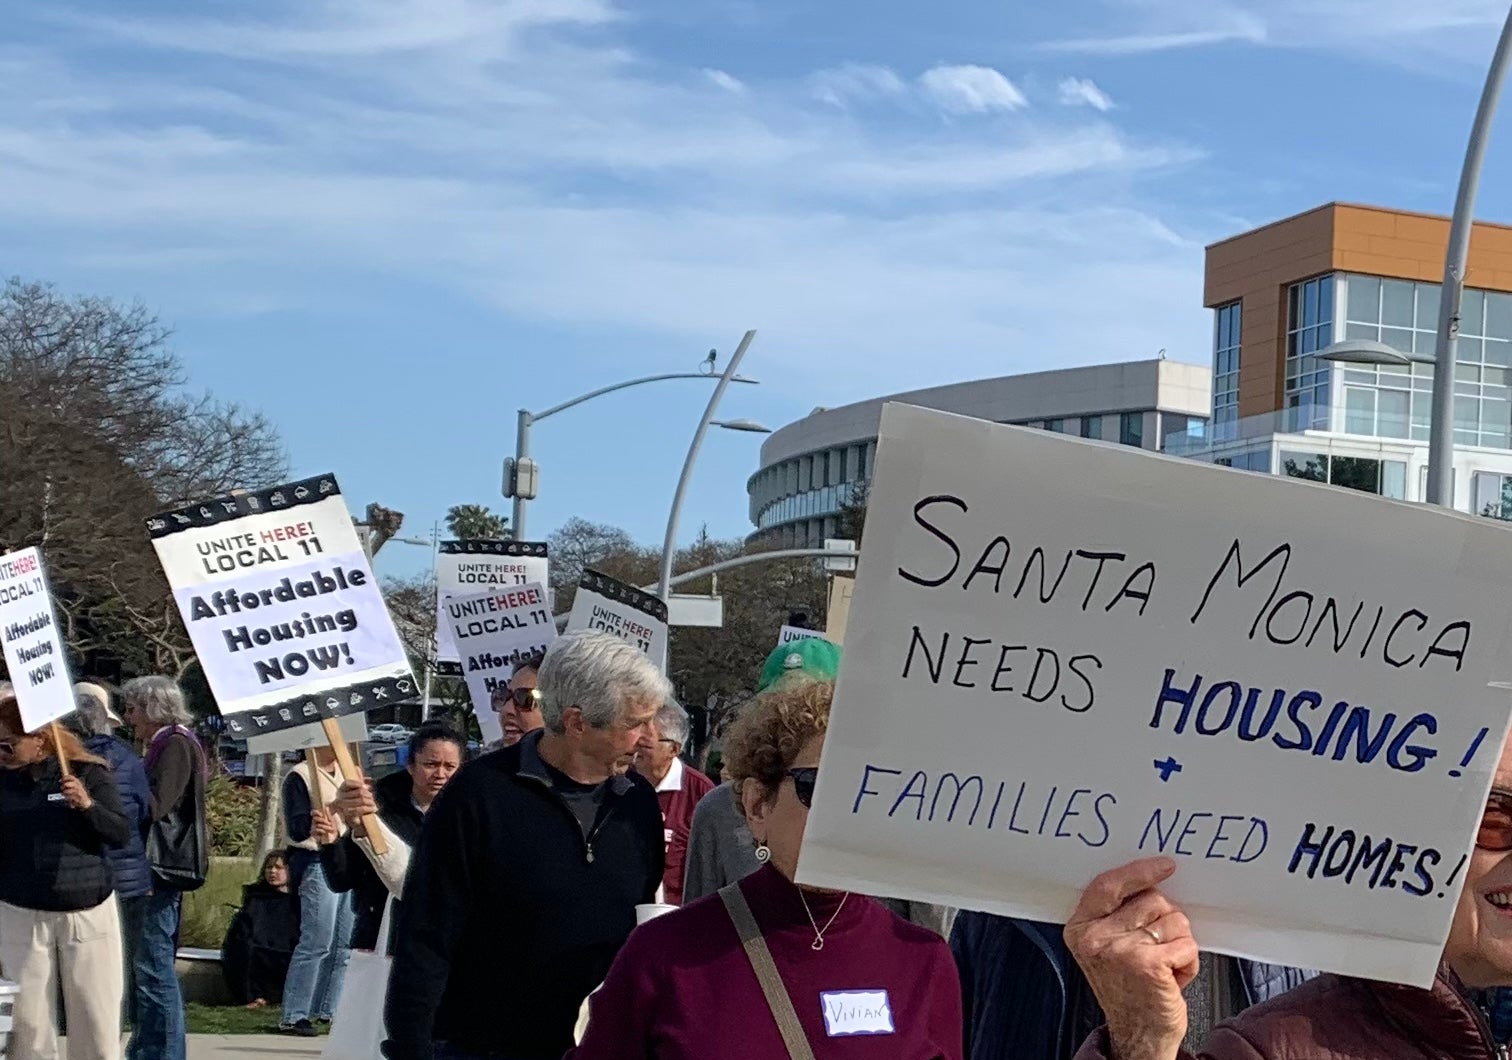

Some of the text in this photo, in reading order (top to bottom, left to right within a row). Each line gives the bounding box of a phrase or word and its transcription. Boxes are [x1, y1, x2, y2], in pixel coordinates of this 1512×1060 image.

[196, 521, 314, 556] UNITE HERE!
[202, 537, 324, 575] LOCAL 11
[458, 563, 527, 574] UNITE HERE!
[458, 573, 527, 585] LOCAL 11
[898, 494, 1471, 672] SANTA MONICA
[0, 577, 43, 605] OCAL 11
[191, 566, 367, 621] Affordable
[5, 611, 51, 643] Affordable
[222, 608, 358, 652] Housing
[455, 610, 548, 639] LOCAL 11
[593, 605, 654, 641] UNITE HERE!
[16, 640, 53, 664] Housing
[253, 641, 356, 685] NOW!
[637, 639, 649, 653] 11
[28, 662, 55, 687] NOW!
[902, 625, 1103, 713] NEEDS
[852, 764, 1468, 898] FAMILIES NEED HOMES!
